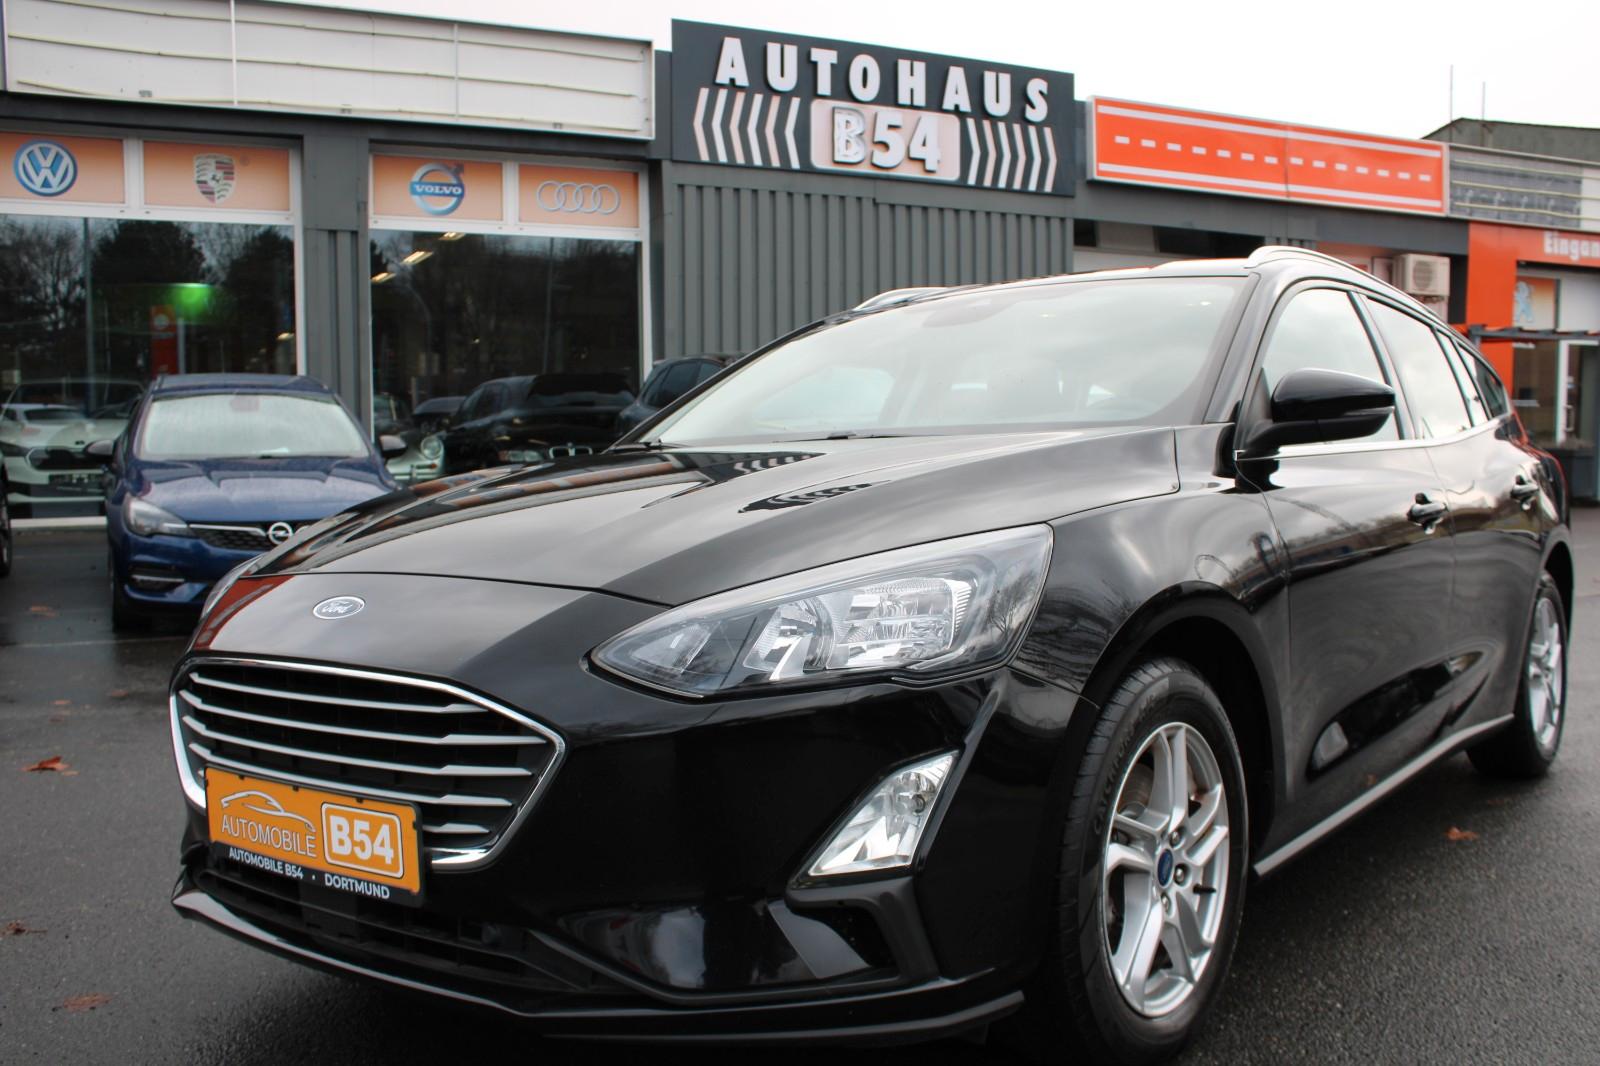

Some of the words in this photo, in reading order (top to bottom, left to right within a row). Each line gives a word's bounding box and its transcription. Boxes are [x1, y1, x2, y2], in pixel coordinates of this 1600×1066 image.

[715, 37, 1049, 123] AUTOHAUS
[832, 106, 942, 172] B54
[415, 184, 463, 195] VOLVO
[221, 814, 317, 858] AUTOMOBILE
[329, 815, 395, 865] B54
[228, 846, 284, 876] AUTOMOBILE
[284, 864, 304, 881] B54
[324, 873, 390, 900] DORTMUND
